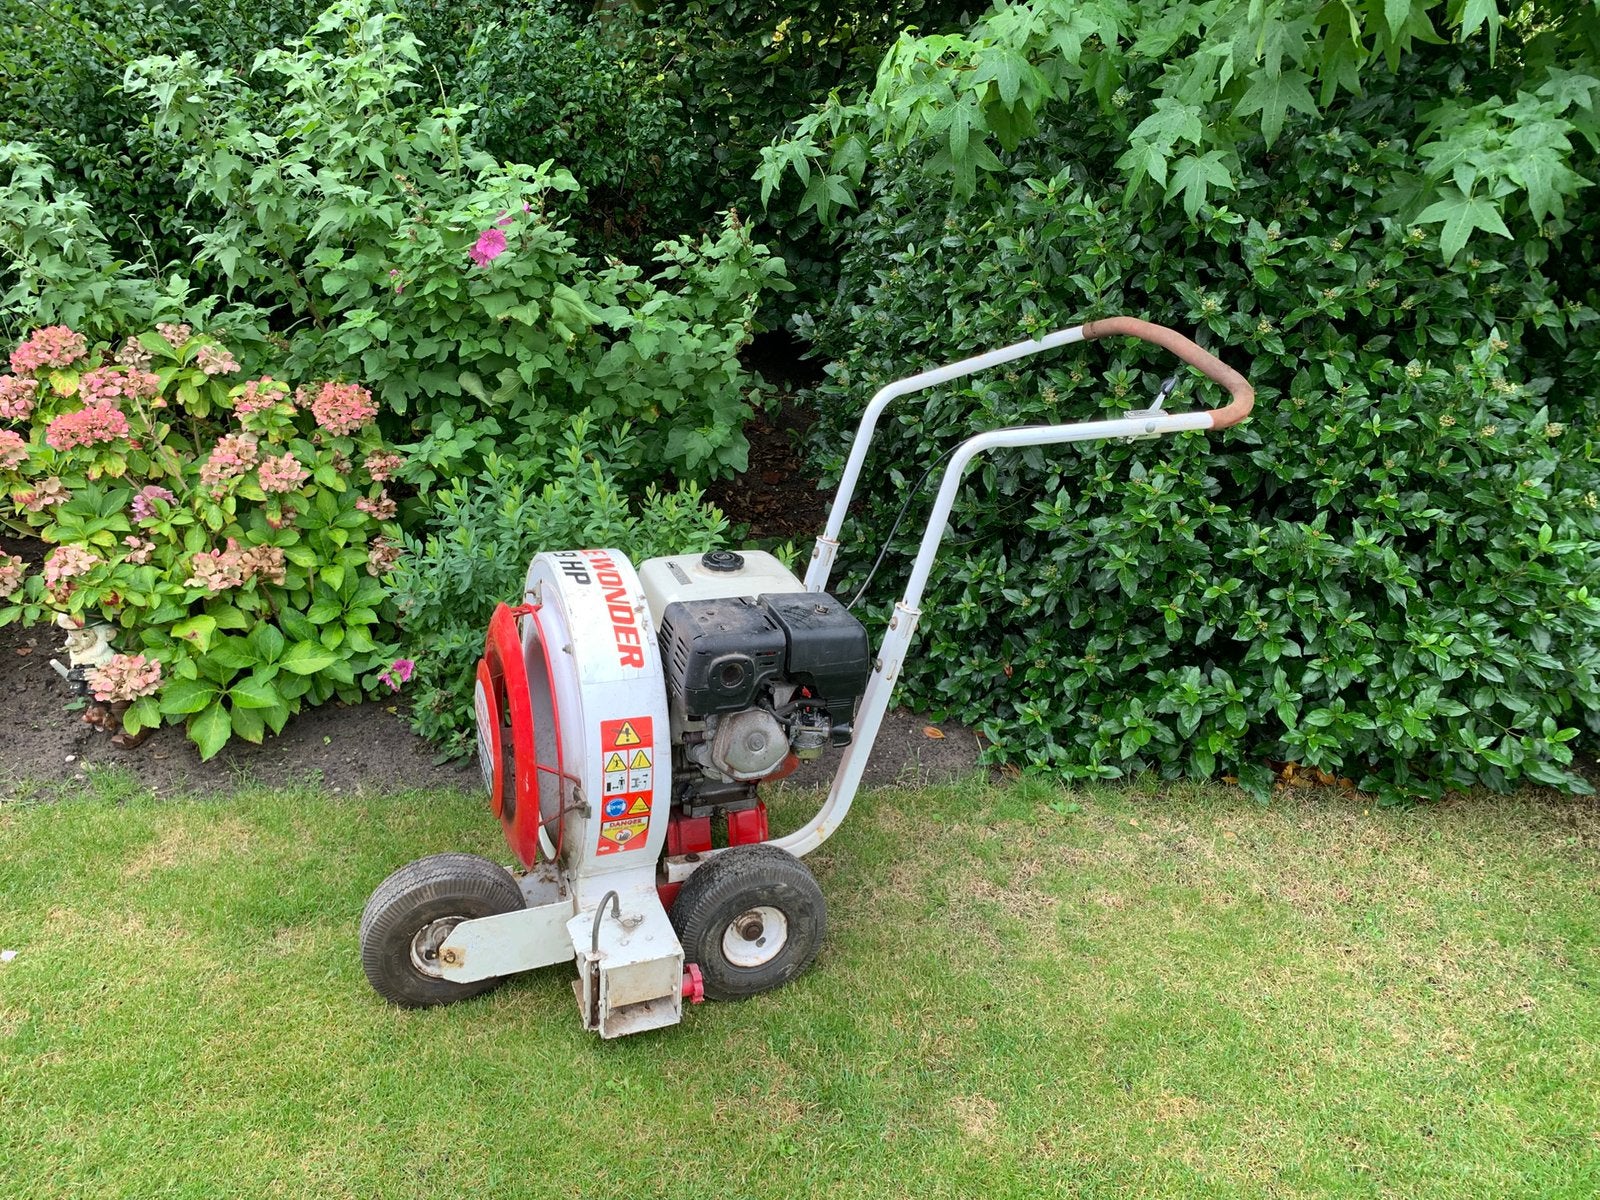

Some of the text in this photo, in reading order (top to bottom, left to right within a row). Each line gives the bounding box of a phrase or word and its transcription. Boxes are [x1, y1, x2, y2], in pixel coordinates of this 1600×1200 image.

[559, 561, 592, 585] HP
[589, 557, 645, 669] WONDER
[609, 818, 642, 827] DANGER
